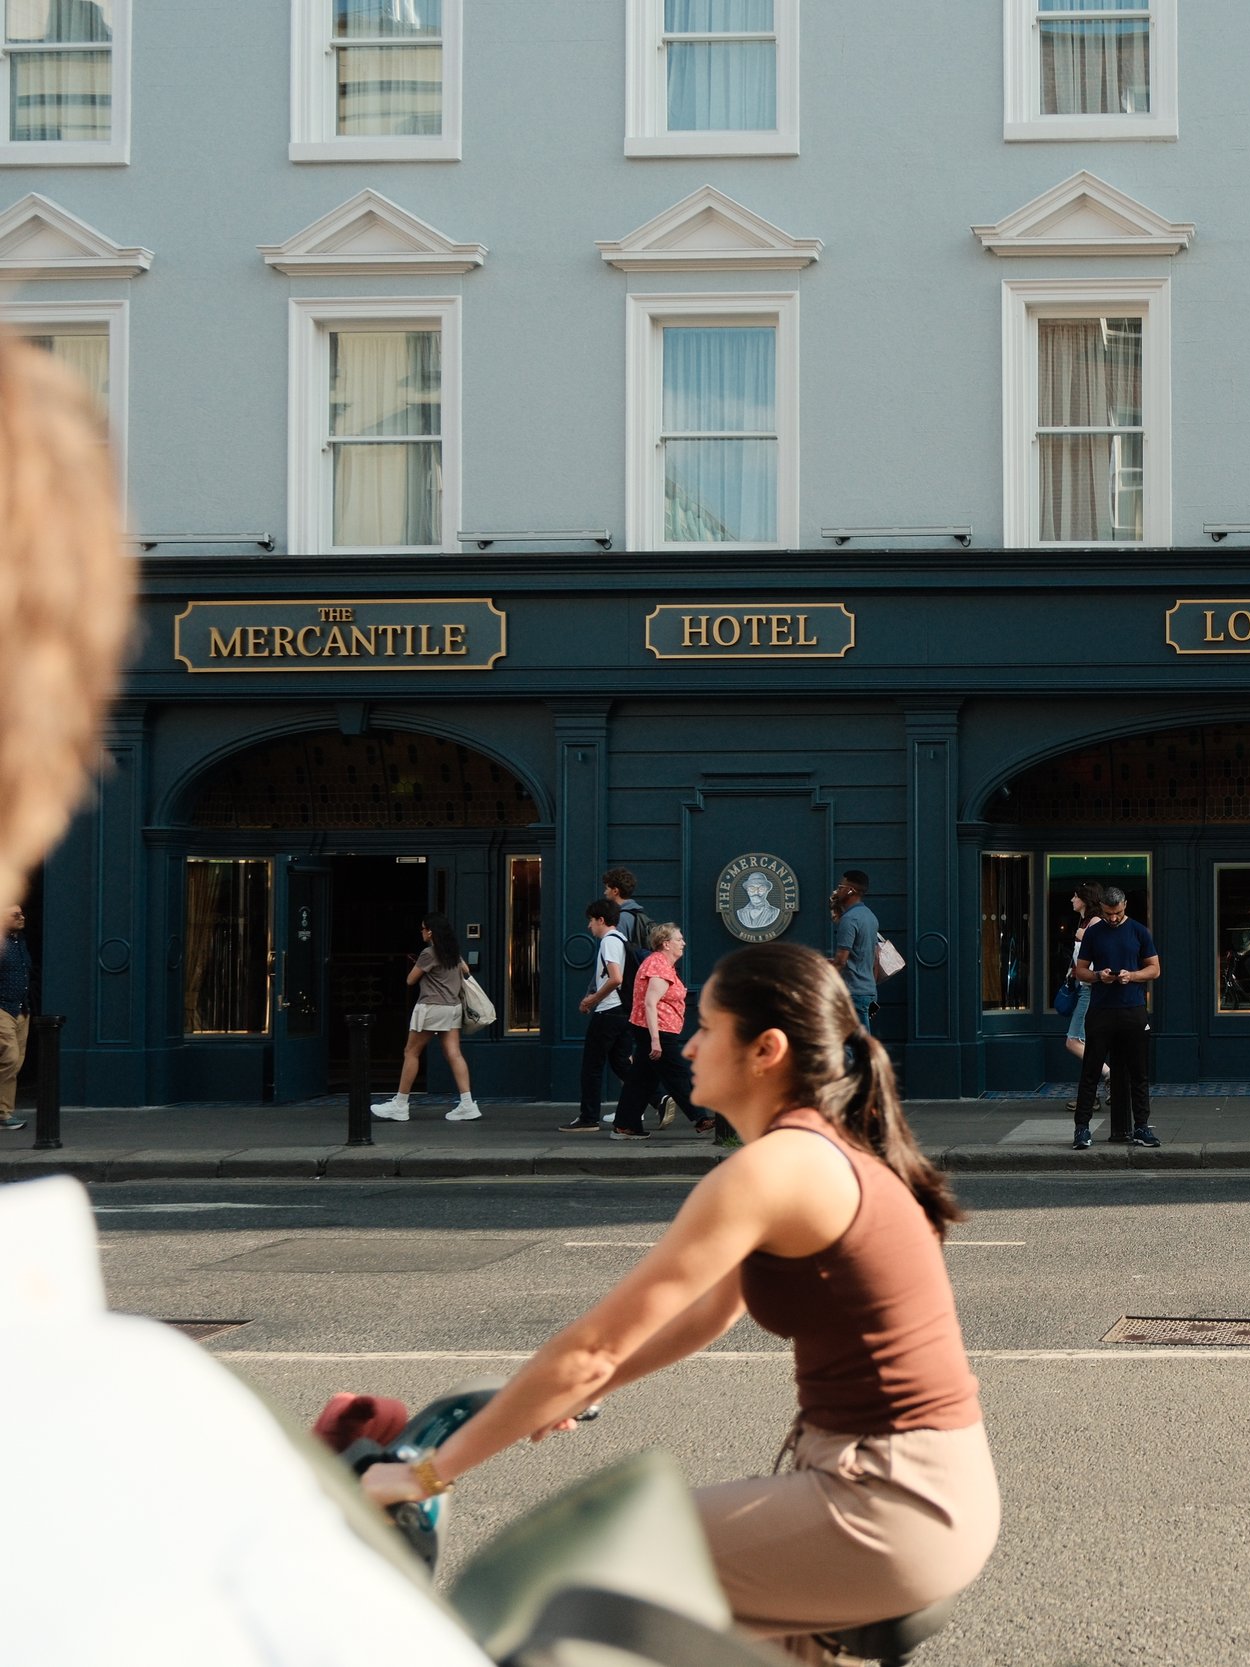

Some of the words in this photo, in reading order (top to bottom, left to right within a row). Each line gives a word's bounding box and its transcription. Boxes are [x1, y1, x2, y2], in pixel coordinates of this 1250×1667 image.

[318, 607, 353, 622] THE
[681, 614, 817, 647] HOTEL
[208, 613, 468, 657] MERCANTILE
[719, 881, 731, 910] THE
[727, 856, 796, 910] MERCANTILE
